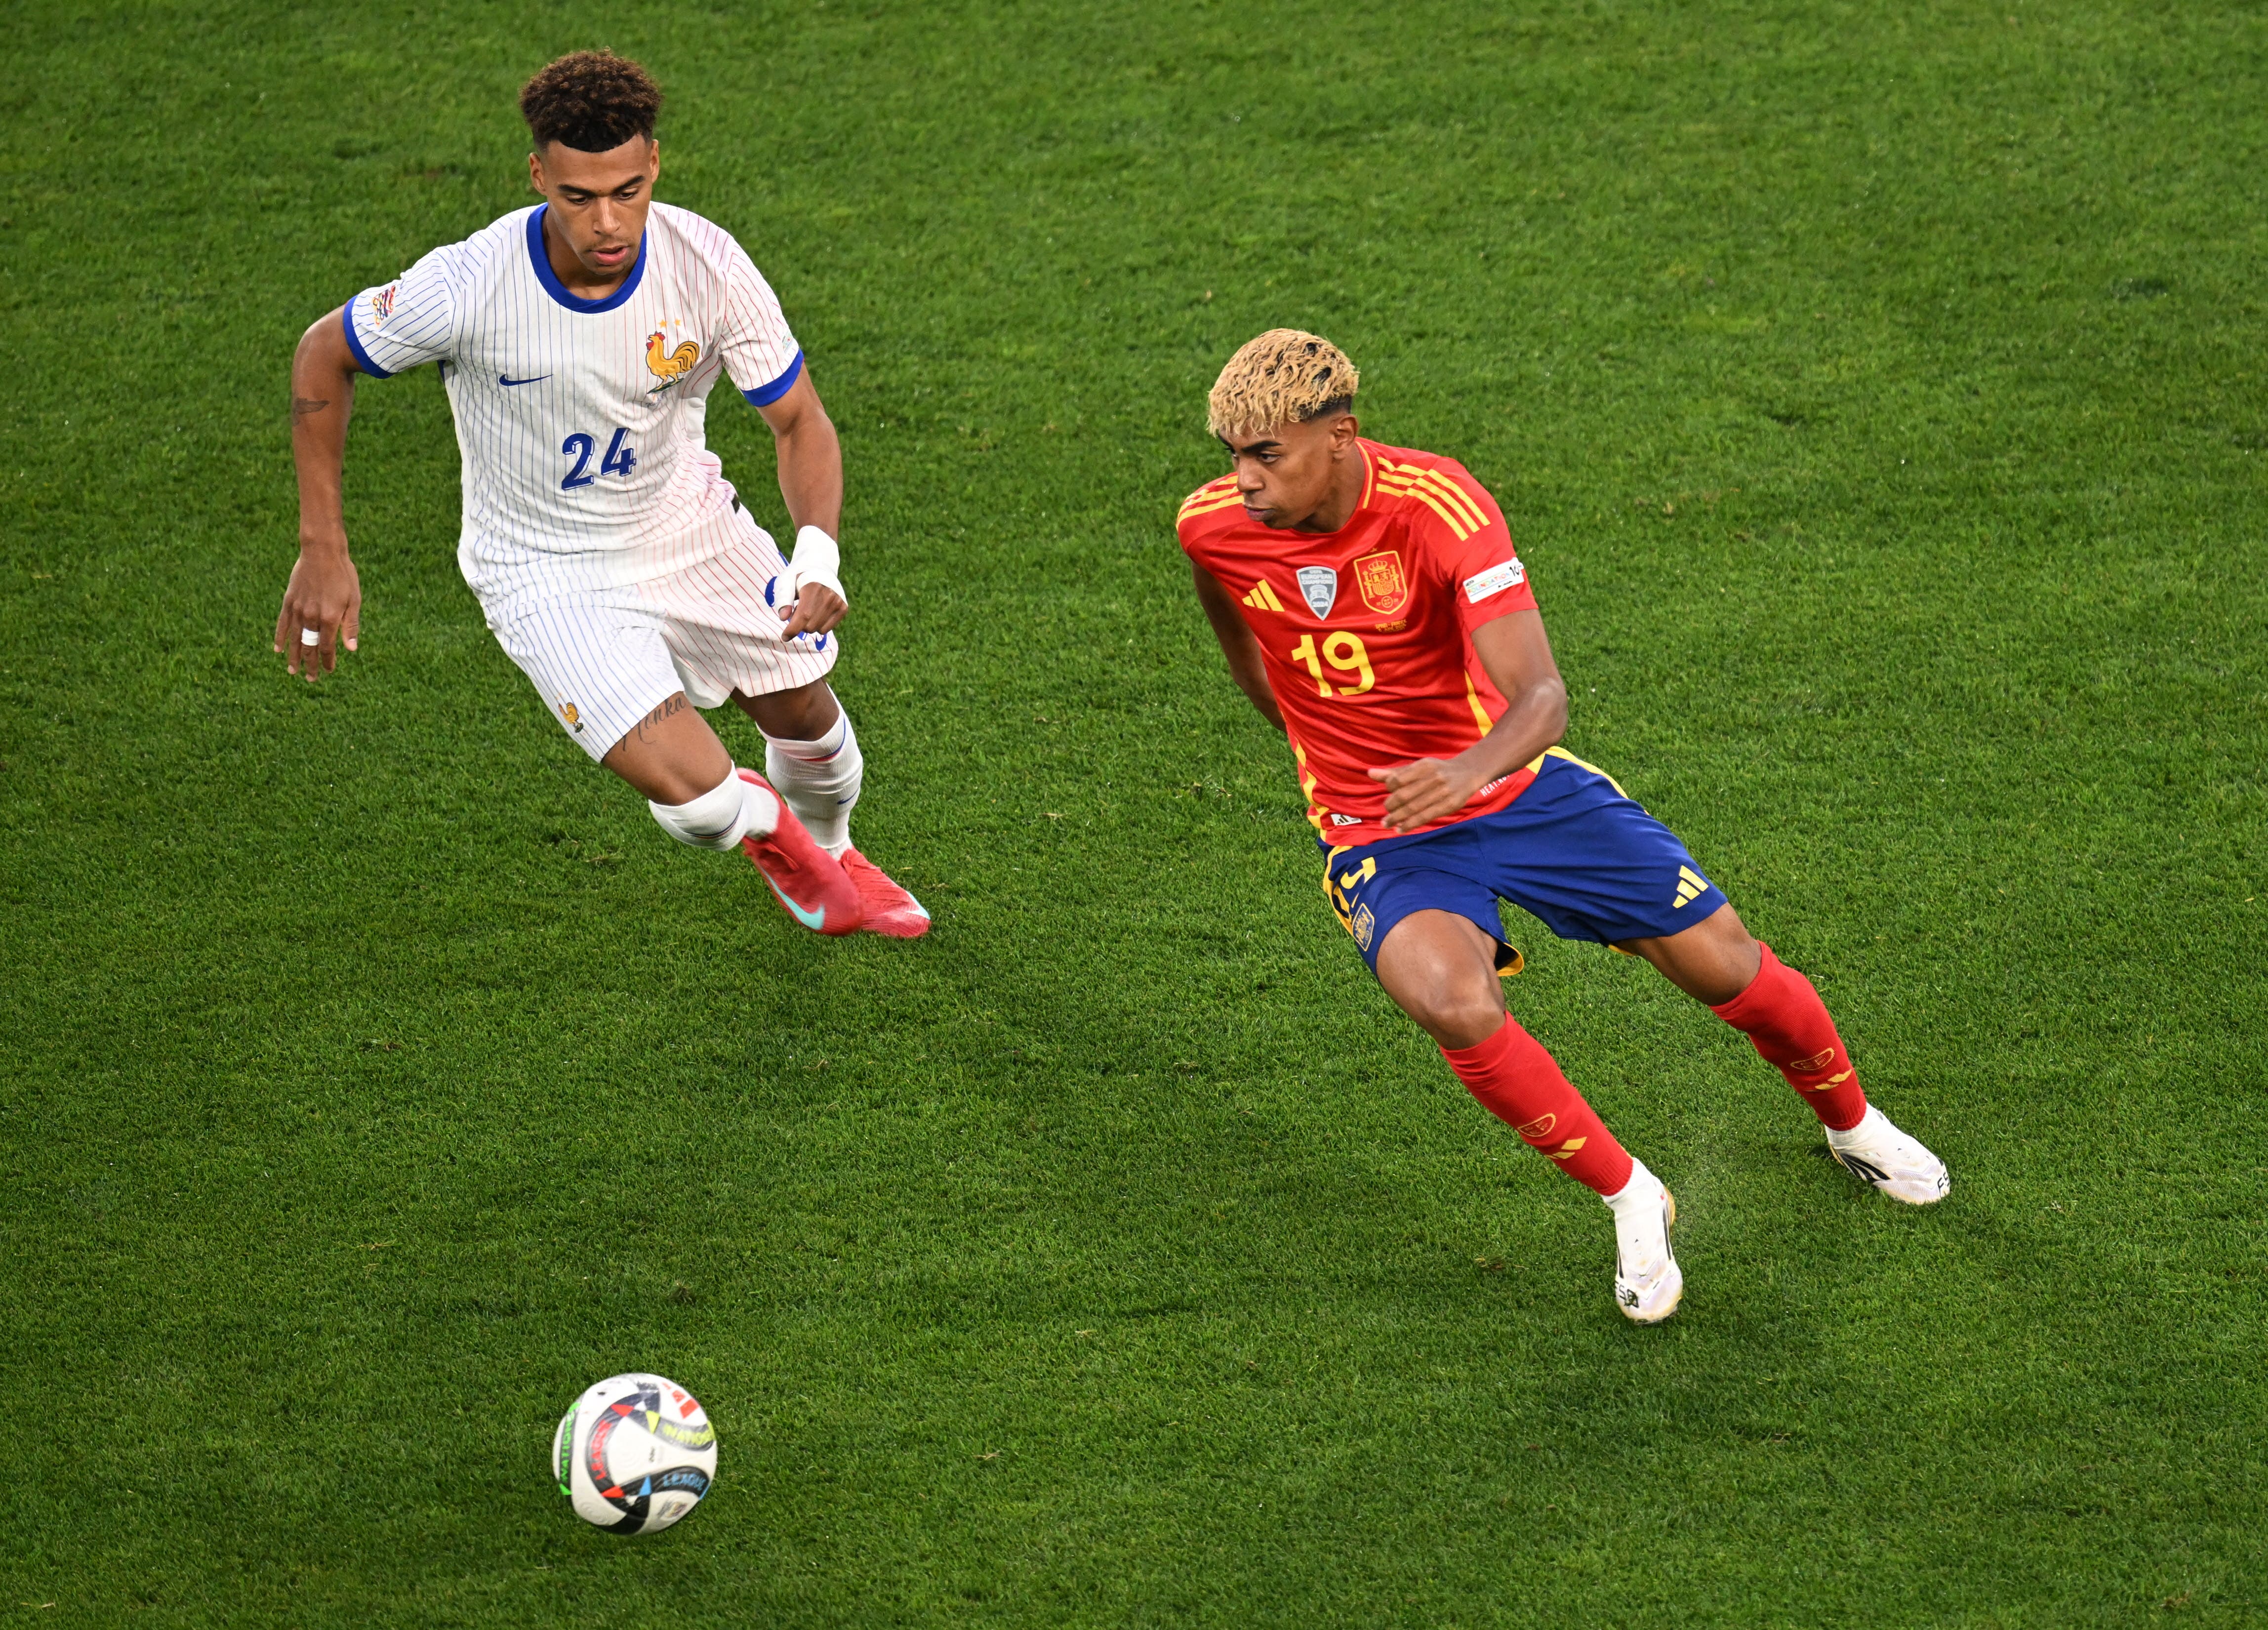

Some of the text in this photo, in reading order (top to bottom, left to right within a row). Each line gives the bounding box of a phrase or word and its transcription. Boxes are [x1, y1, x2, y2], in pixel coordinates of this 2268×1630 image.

[561, 427, 637, 490] 24
[1467, 573, 1510, 593] FOUNDATION
[1291, 631, 1375, 697] 19
